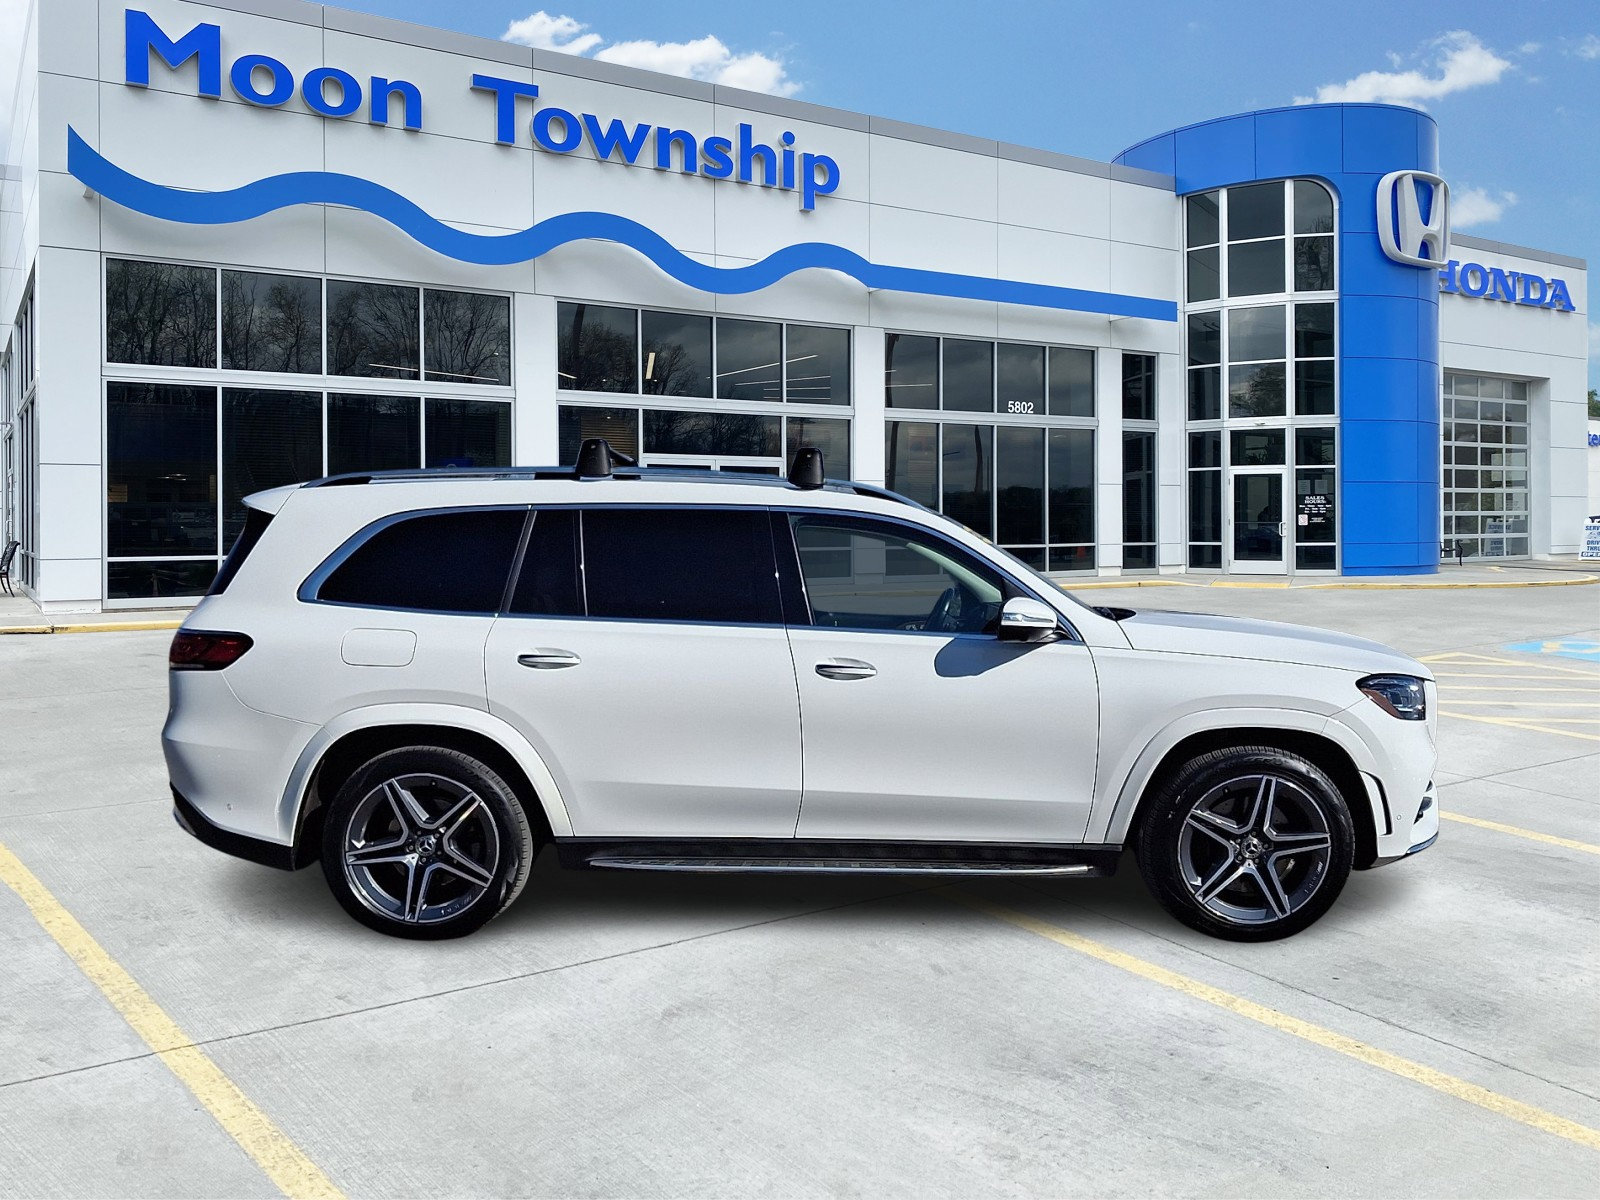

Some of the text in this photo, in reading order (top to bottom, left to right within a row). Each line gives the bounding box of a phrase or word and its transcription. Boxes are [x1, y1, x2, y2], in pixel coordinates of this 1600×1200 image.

[124, 8, 841, 213] Moon Township
[1007, 401, 1034, 414] 5802
